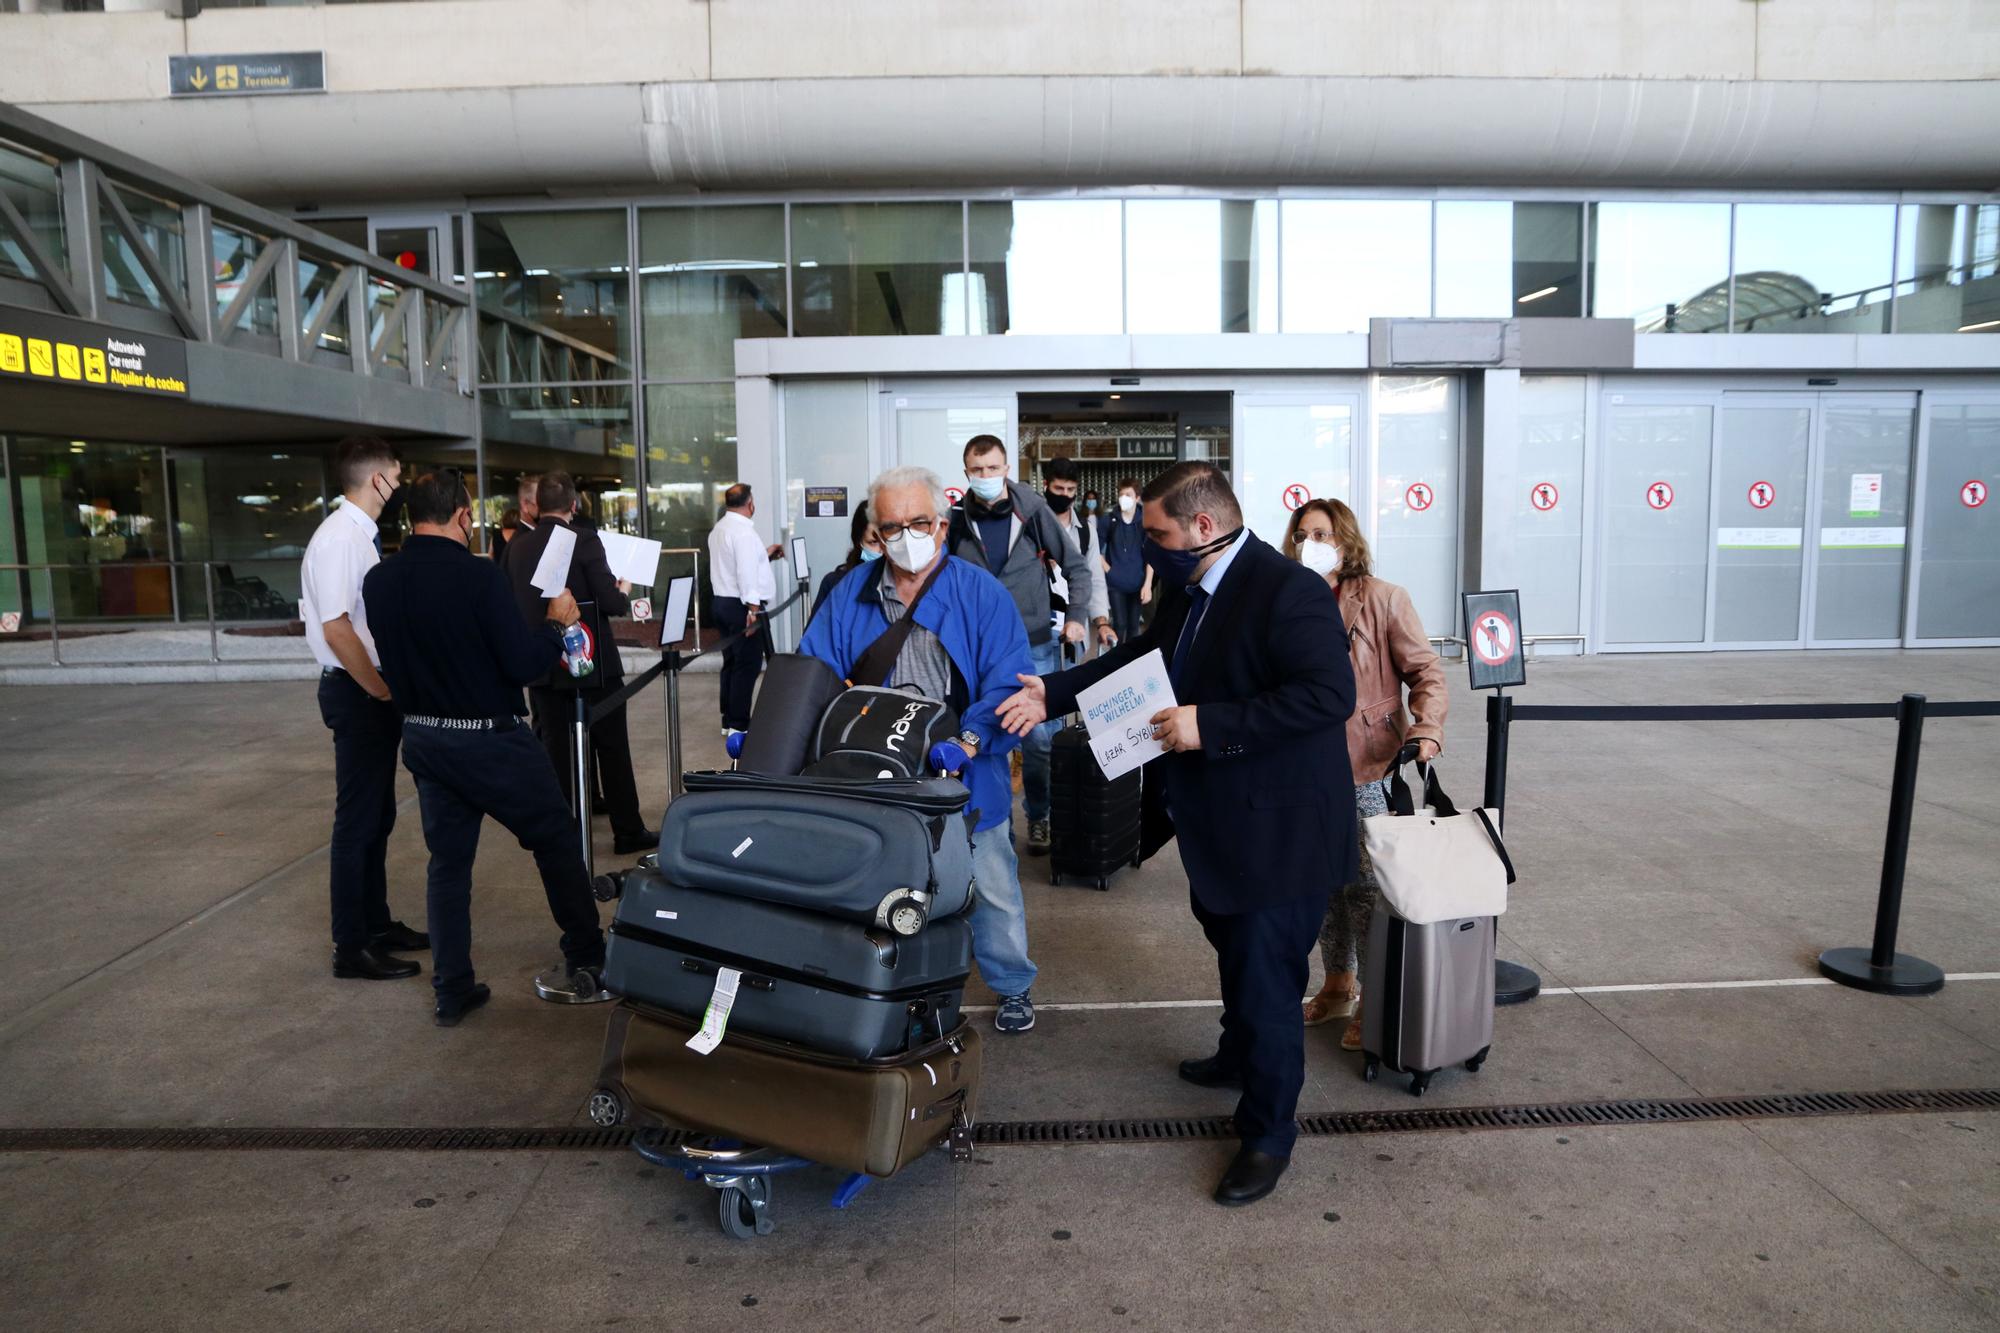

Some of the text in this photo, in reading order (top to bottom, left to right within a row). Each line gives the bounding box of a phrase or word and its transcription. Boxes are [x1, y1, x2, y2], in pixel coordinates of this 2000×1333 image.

[244, 65, 281, 75] Terminal
[244, 76, 289, 87] Terminal
[107, 337, 146, 356] Autoverleih
[108, 352, 142, 371] Car rental
[111, 368, 186, 393] Alquiler de coches
[1127, 441, 1141, 454] LA
[1088, 686, 1135, 720] BUCHINGER
[1103, 693, 1146, 723] WILHELMI
